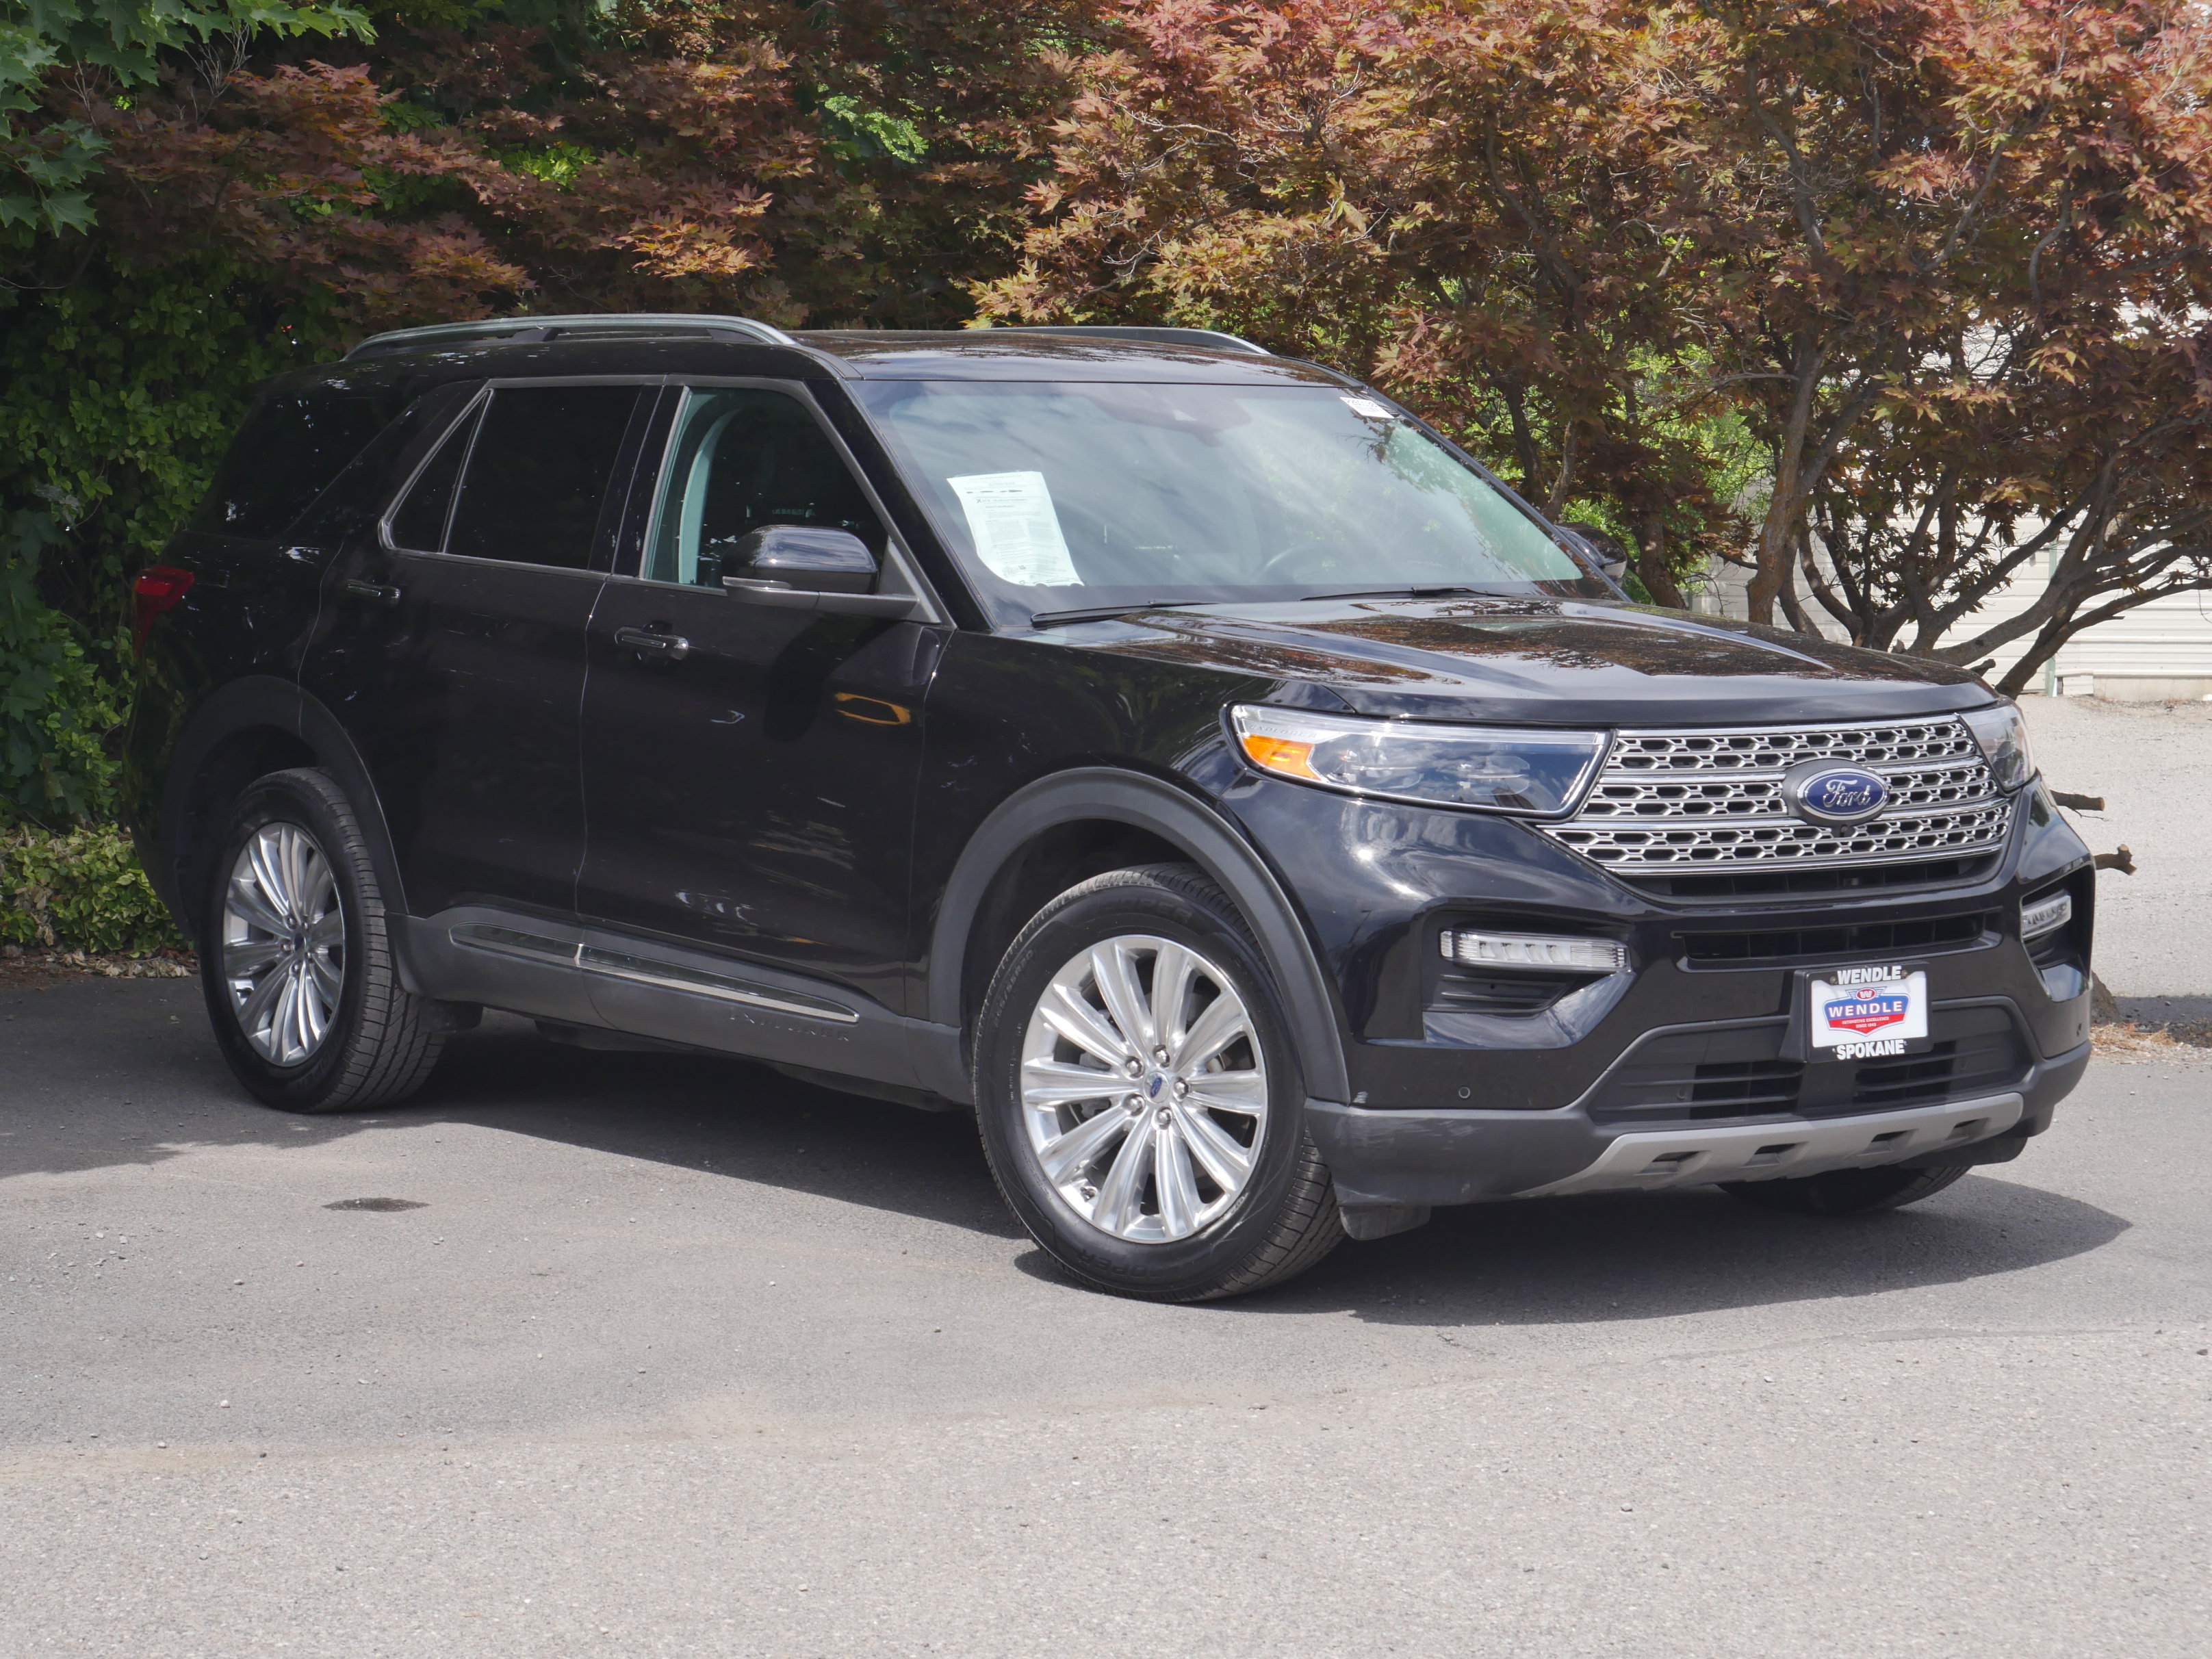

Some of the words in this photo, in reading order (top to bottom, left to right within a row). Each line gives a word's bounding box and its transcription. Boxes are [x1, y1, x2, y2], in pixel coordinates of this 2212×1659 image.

[1249, 724, 1317, 738] EXPLORER
[1823, 779, 1871, 808] Ford
[1837, 966, 1902, 985] WENDLE
[1860, 990, 1873, 999] W
[1829, 1001, 1902, 1018] WENDLE
[730, 1006, 851, 1042] EXPLORER
[1836, 1039, 1905, 1060] SPOKANE
